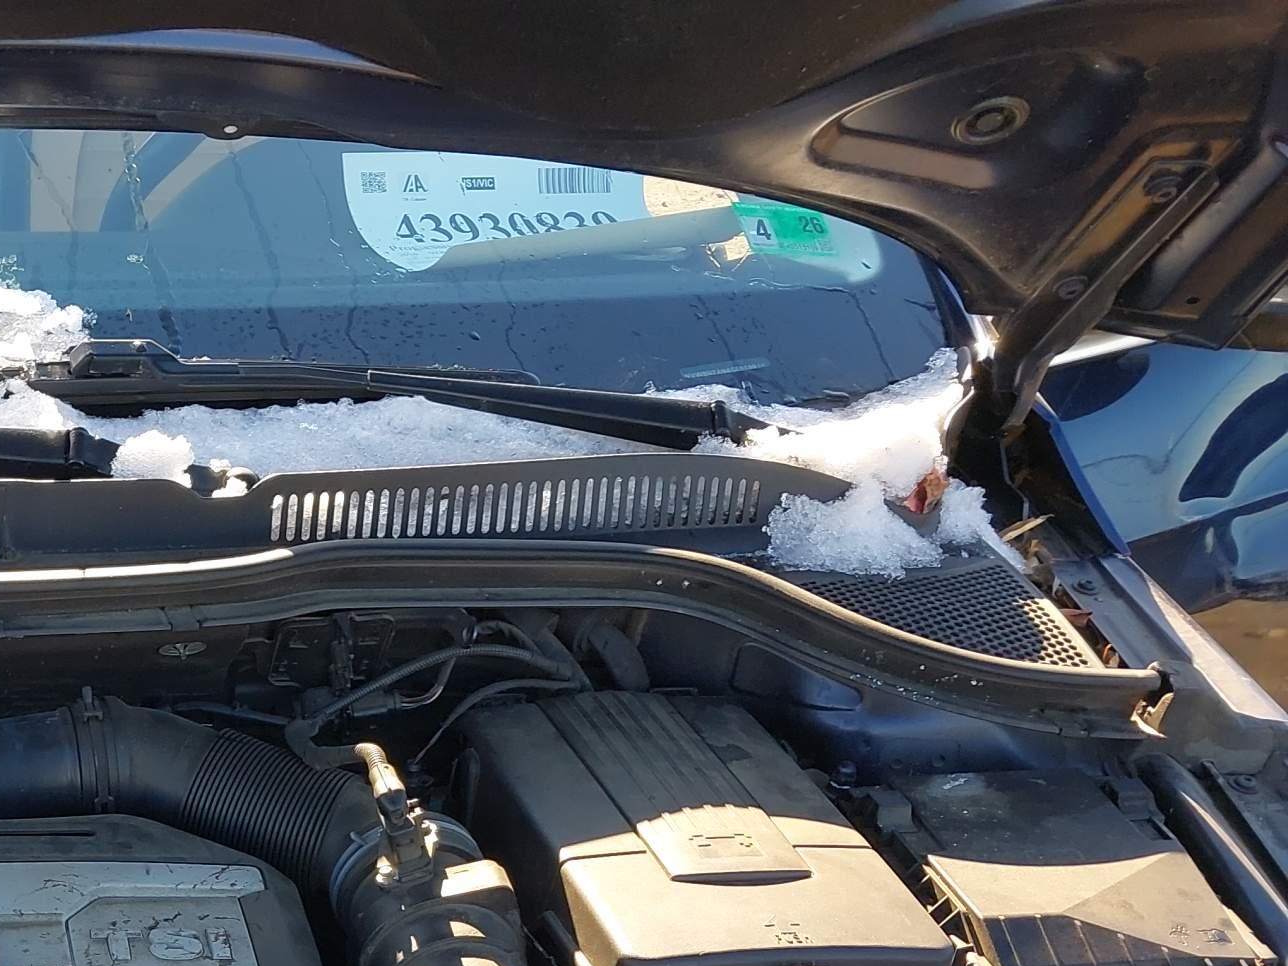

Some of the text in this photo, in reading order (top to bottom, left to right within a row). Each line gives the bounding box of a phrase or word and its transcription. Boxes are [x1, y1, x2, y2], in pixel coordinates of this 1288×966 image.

[756, 216, 824, 240] 4 26
[90, 928, 233, 961] TSI
